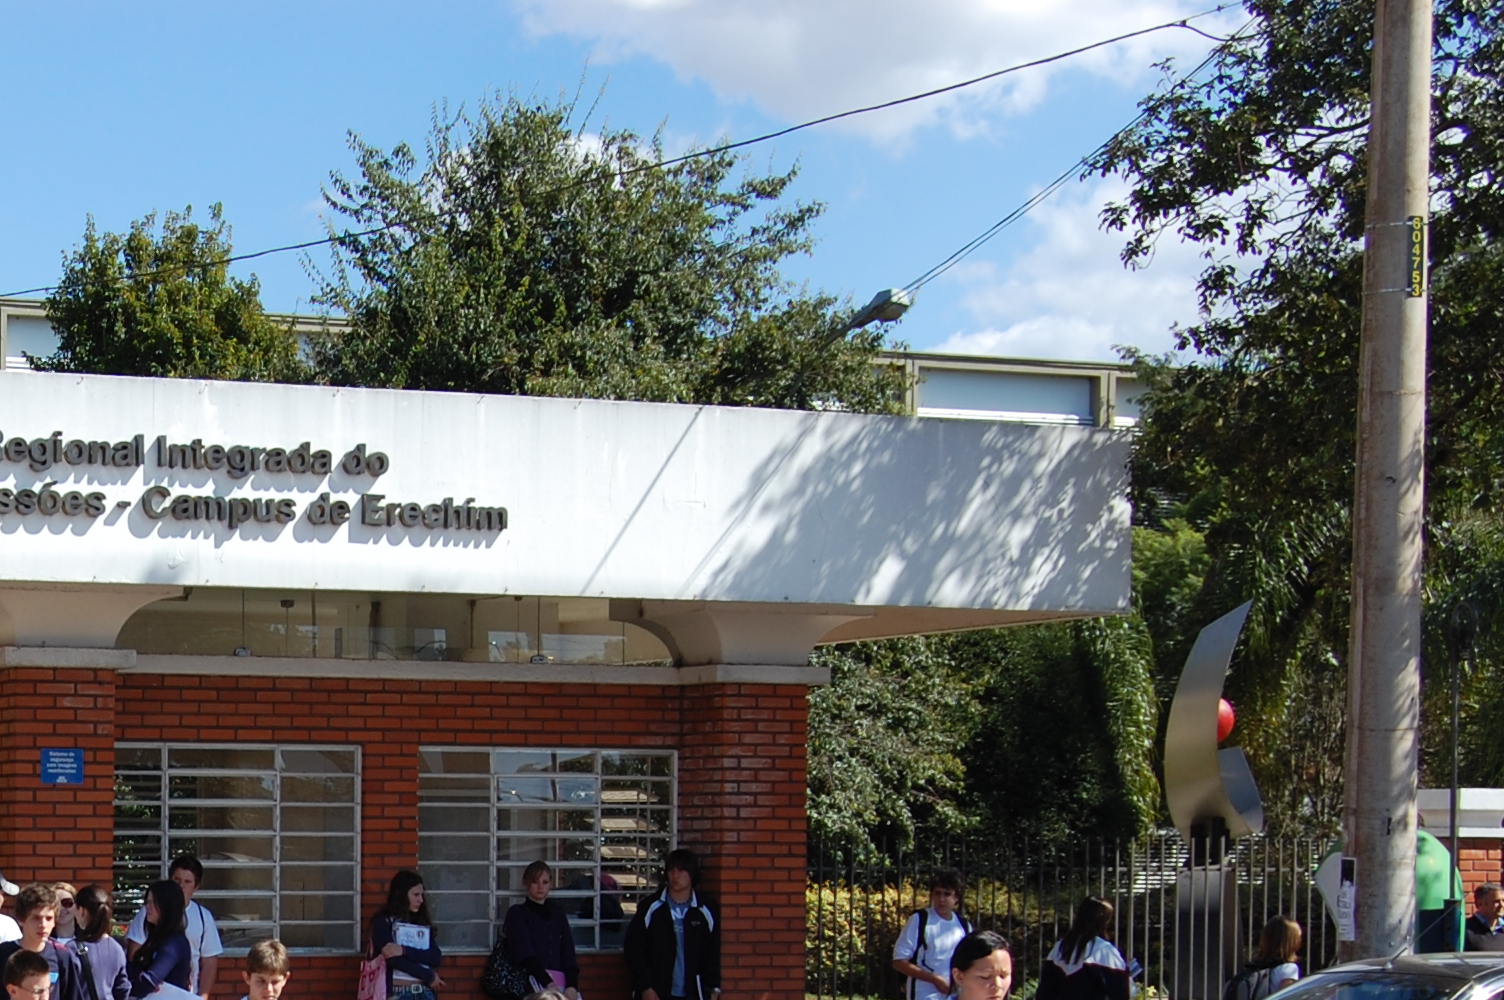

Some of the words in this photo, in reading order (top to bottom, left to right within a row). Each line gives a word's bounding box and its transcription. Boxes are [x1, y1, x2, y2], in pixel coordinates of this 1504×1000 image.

[1411, 217, 1421, 297] 604753
[157, 434, 332, 479] Integrada
[342, 443, 390, 477] do
[141, 484, 297, 530] Campus
[307, 492, 351, 525] de
[362, 493, 508, 531] Erechim
